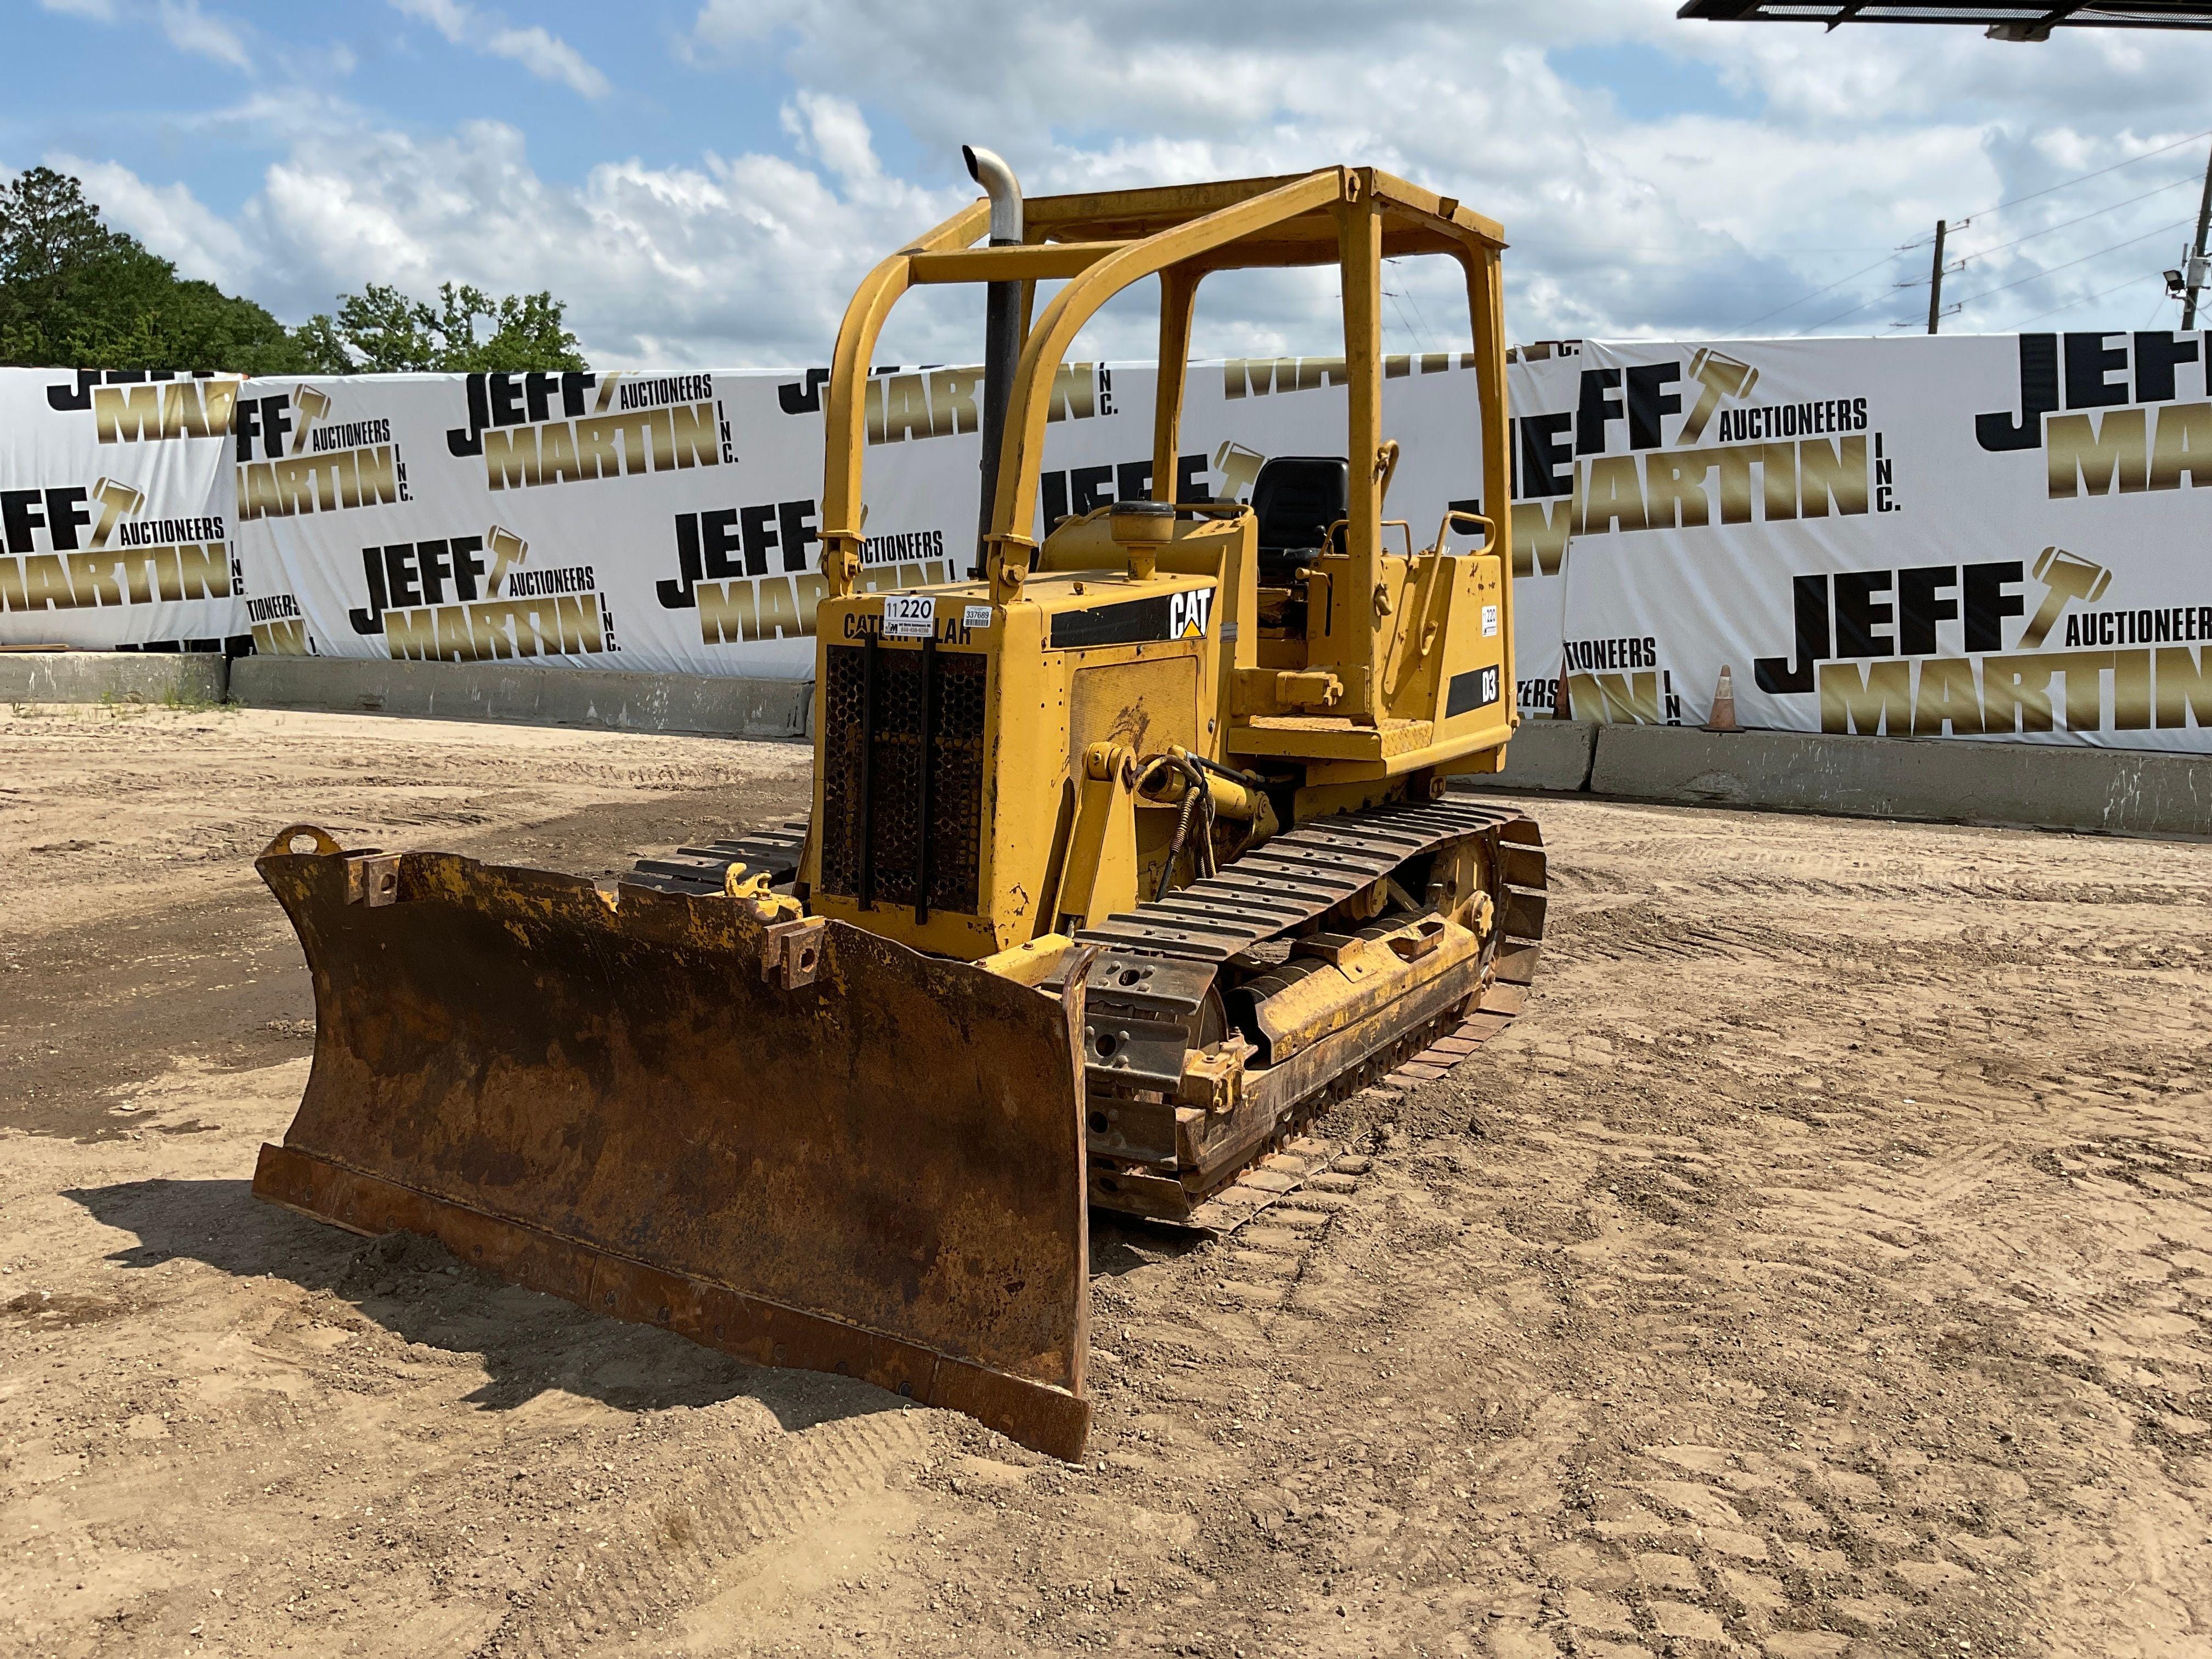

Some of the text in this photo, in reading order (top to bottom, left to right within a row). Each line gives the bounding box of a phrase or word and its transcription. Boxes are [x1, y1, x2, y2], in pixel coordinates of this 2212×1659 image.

[620, 374, 713, 410] AUCTIONEERS
[822, 362, 1094, 445] ARN
[1719, 398, 1867, 442] AUCTIONEERS
[1976, 332, 2212, 452] JEF
[313, 419, 390, 452] AUCTIONEERS
[484, 403, 719, 491] MARTIN
[718, 400, 738, 463] INC.
[237, 445, 397, 521] ARTIN
[394, 444, 413, 501] INC.
[1570, 434, 1869, 536] ARTIN
[1875, 432, 1900, 512] INC.
[120, 517, 225, 546] AUCTIONEERS
[656, 499, 819, 609] JEFF
[859, 531, 943, 564] CTIONEERS
[349, 536, 484, 635] JEFF
[509, 566, 595, 597] AUCTIONEERS
[383, 594, 603, 662] MARTIN
[600, 592, 622, 652] INC.
[844, 613, 971, 645] CATLAR
[966, 611, 989, 619] 337689
[1170, 588, 1210, 640] CAT
[1755, 561, 2024, 693] JEFF
[1482, 669, 1496, 702] D3
